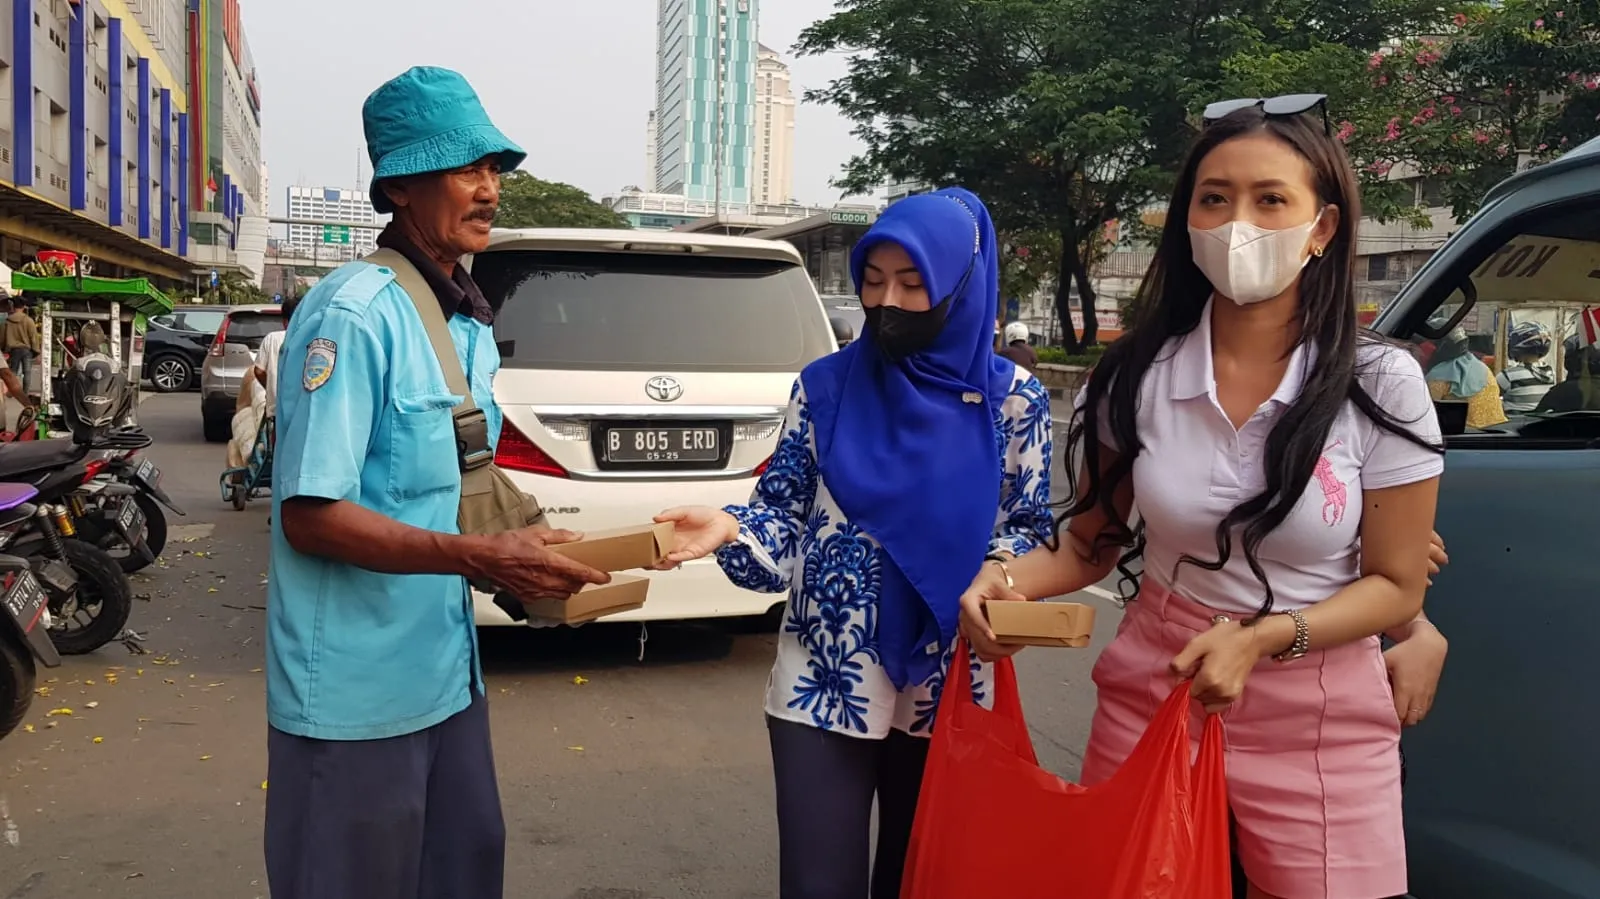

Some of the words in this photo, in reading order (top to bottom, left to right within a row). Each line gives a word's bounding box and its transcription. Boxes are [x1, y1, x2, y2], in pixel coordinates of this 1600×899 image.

[831, 213, 866, 223] GLODOK
[610, 432, 620, 450] B
[635, 431, 668, 450] 805
[682, 430, 715, 449] ERD
